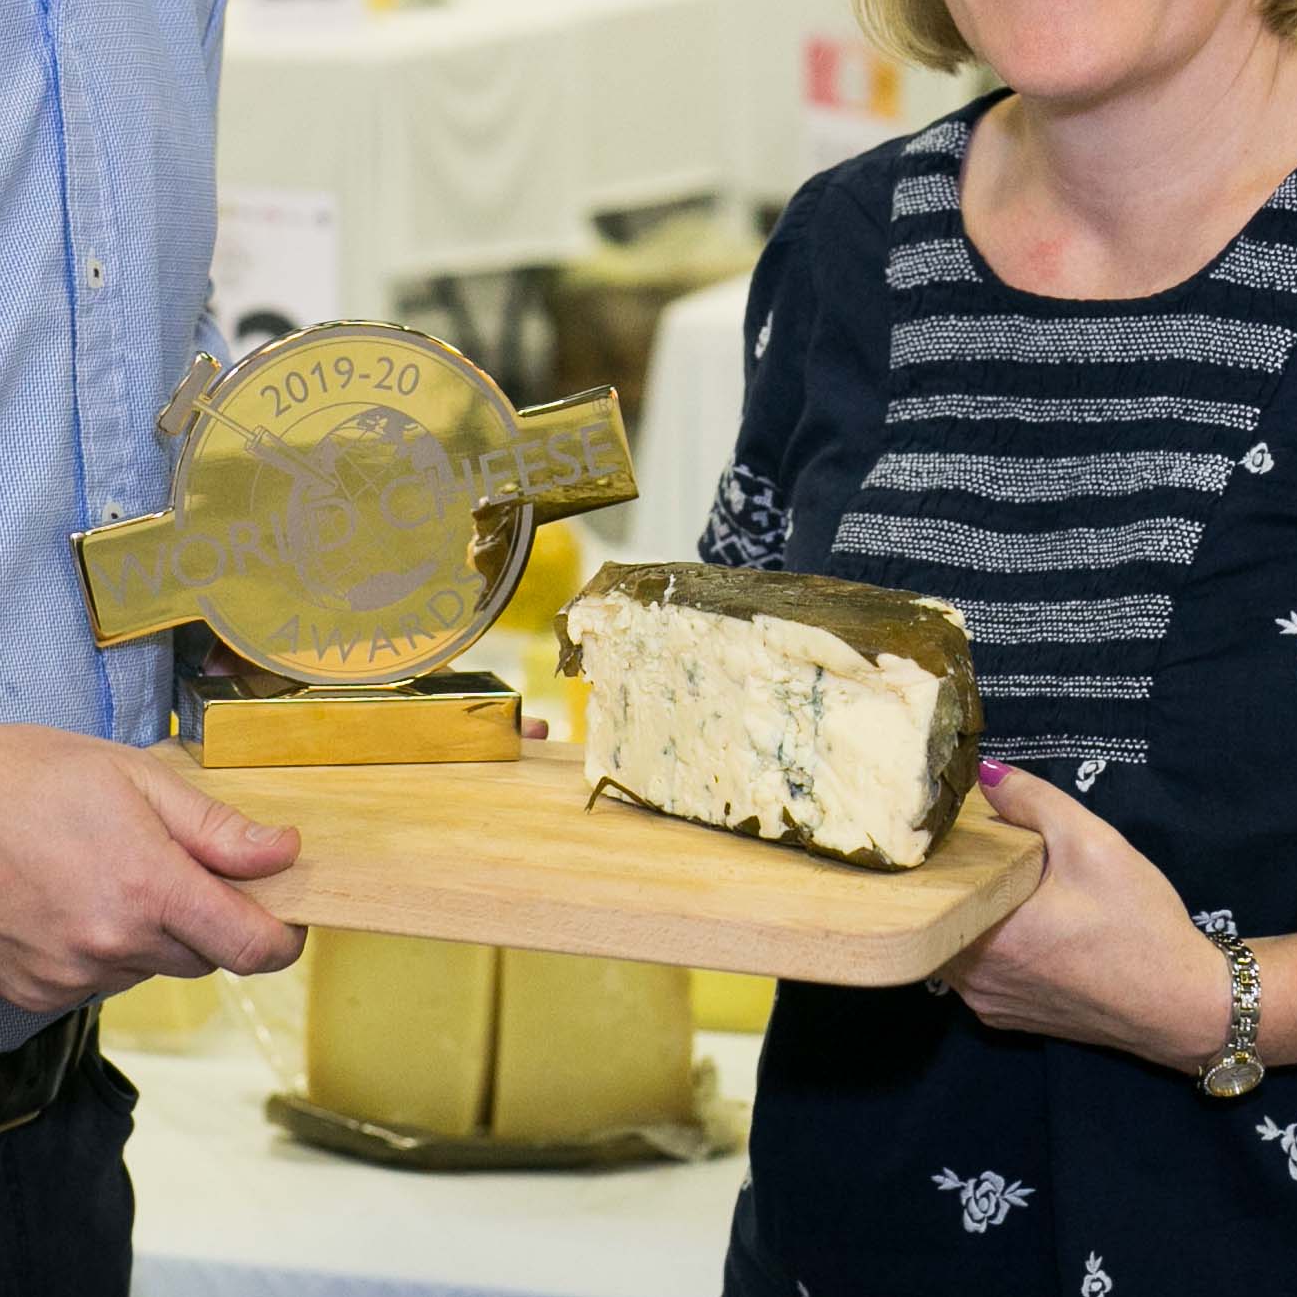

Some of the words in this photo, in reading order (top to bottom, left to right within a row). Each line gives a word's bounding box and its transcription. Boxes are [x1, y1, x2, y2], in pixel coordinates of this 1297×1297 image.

[260, 356, 421, 418] 2019-20
[92, 500, 358, 607] WORLD
[379, 420, 619, 531] CHEESE
[266, 564, 488, 664] AWARDS
